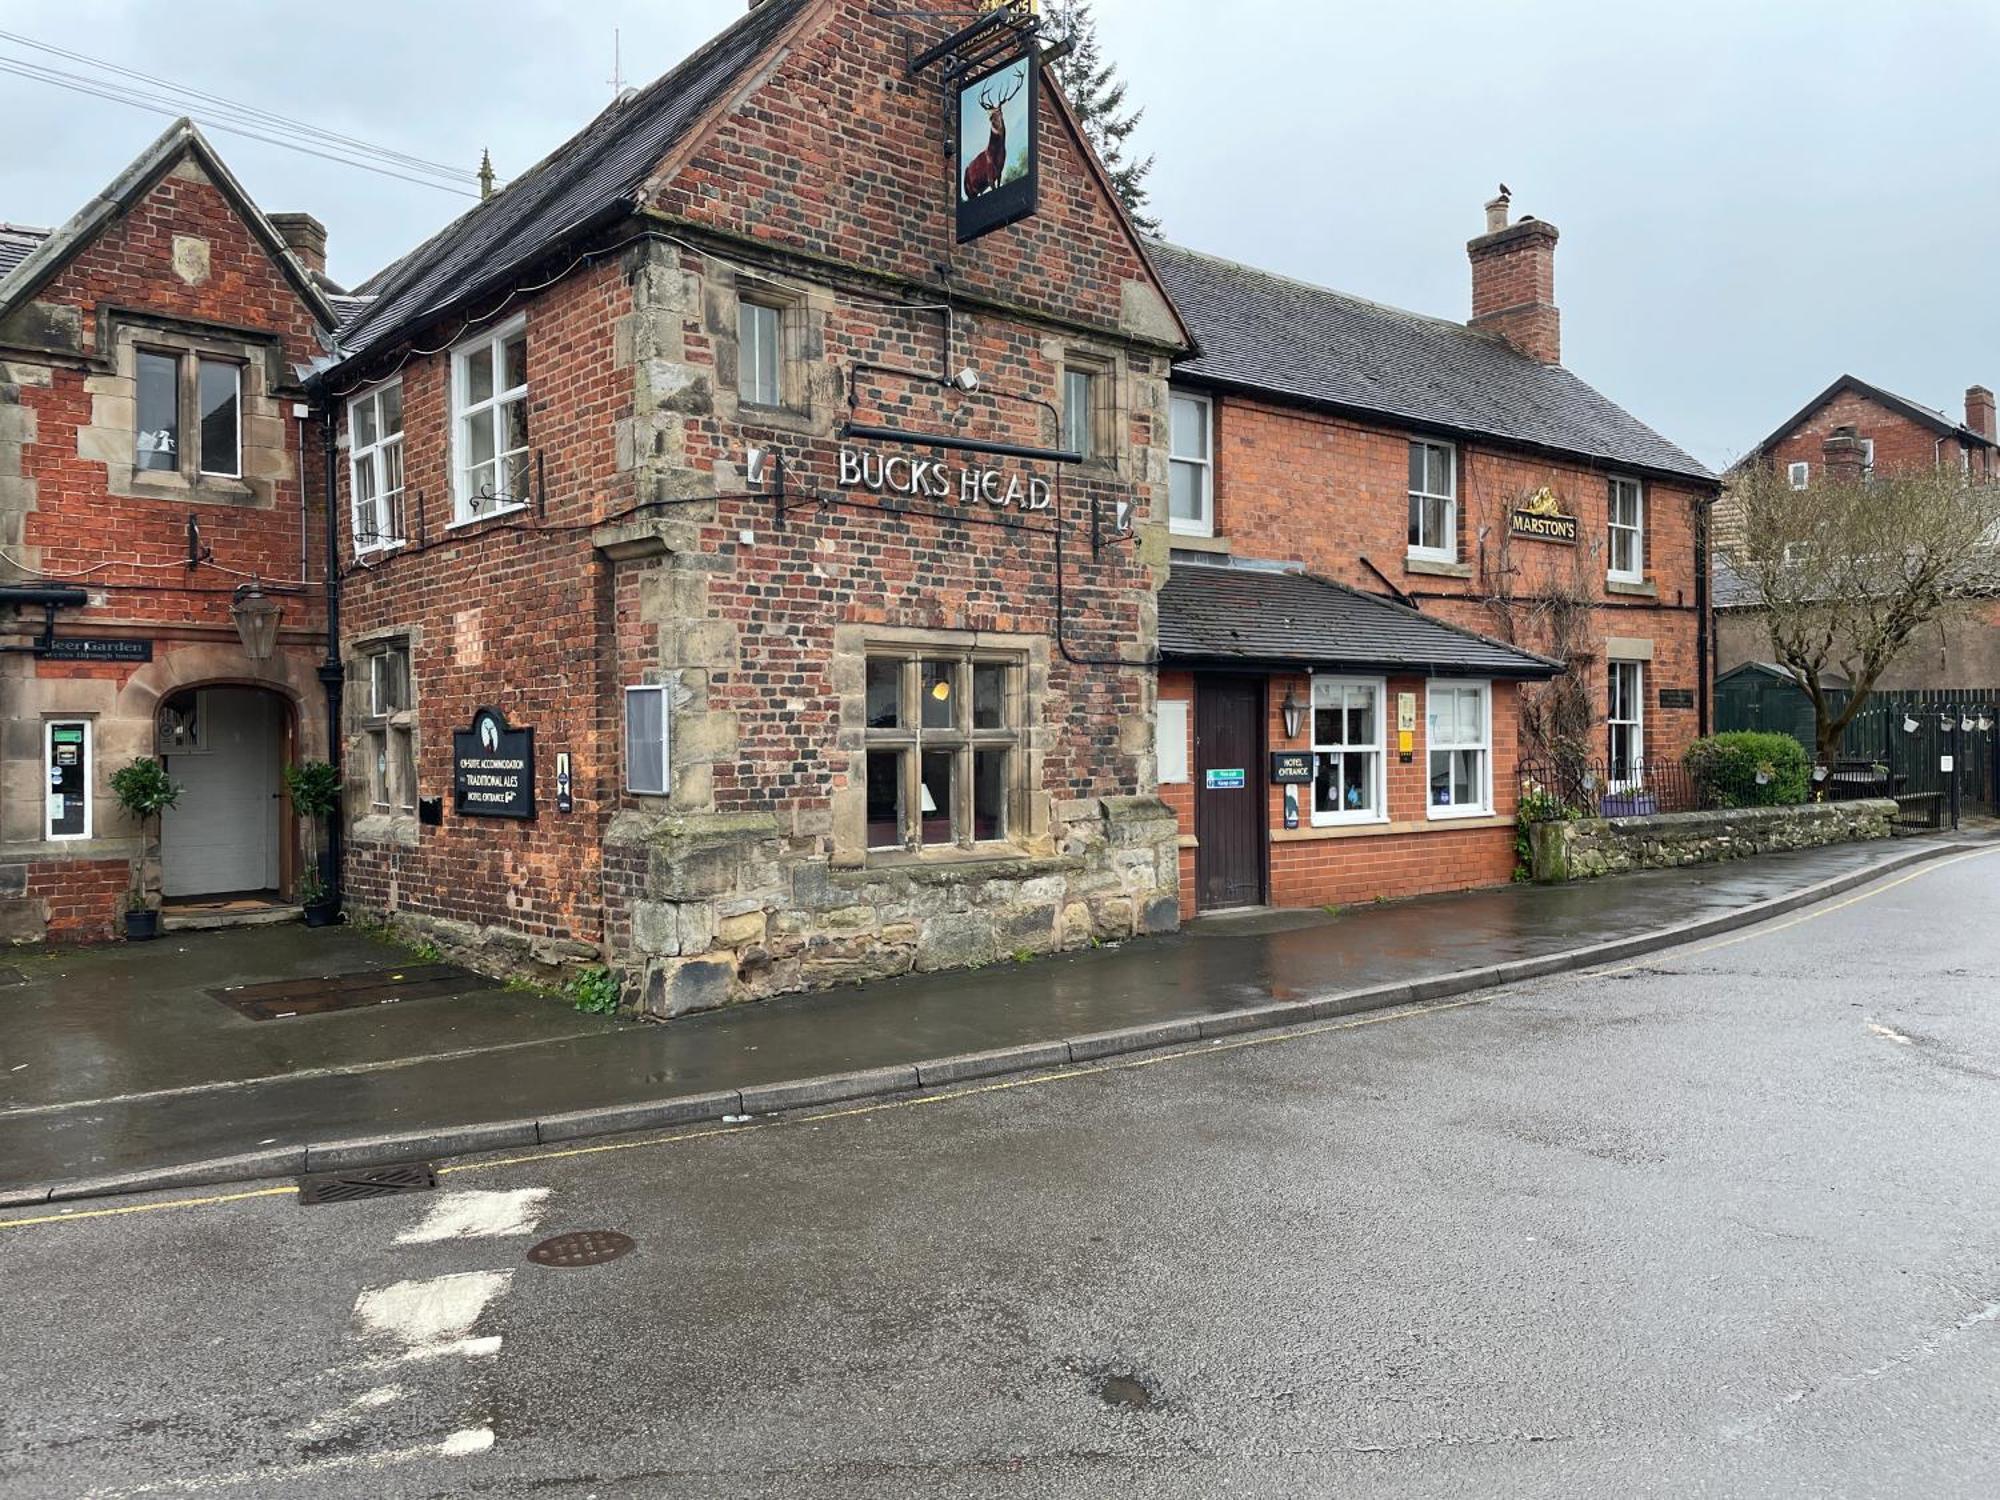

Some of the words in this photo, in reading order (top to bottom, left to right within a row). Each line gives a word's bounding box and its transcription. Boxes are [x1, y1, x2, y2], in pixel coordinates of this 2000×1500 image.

[839, 449, 949, 496] BUCKS
[960, 468, 1050, 510] HEAD
[1512, 515, 1575, 538] MARSTON'S
[88, 640, 142, 651] Garden
[1284, 758, 1304, 767] HOTEL
[1278, 767, 1309, 776] ENTRANCE
[466, 774, 504, 787] TRADITIONAL
[503, 775, 518, 787] ALES
[482, 793, 505, 802] ENTRANCE
